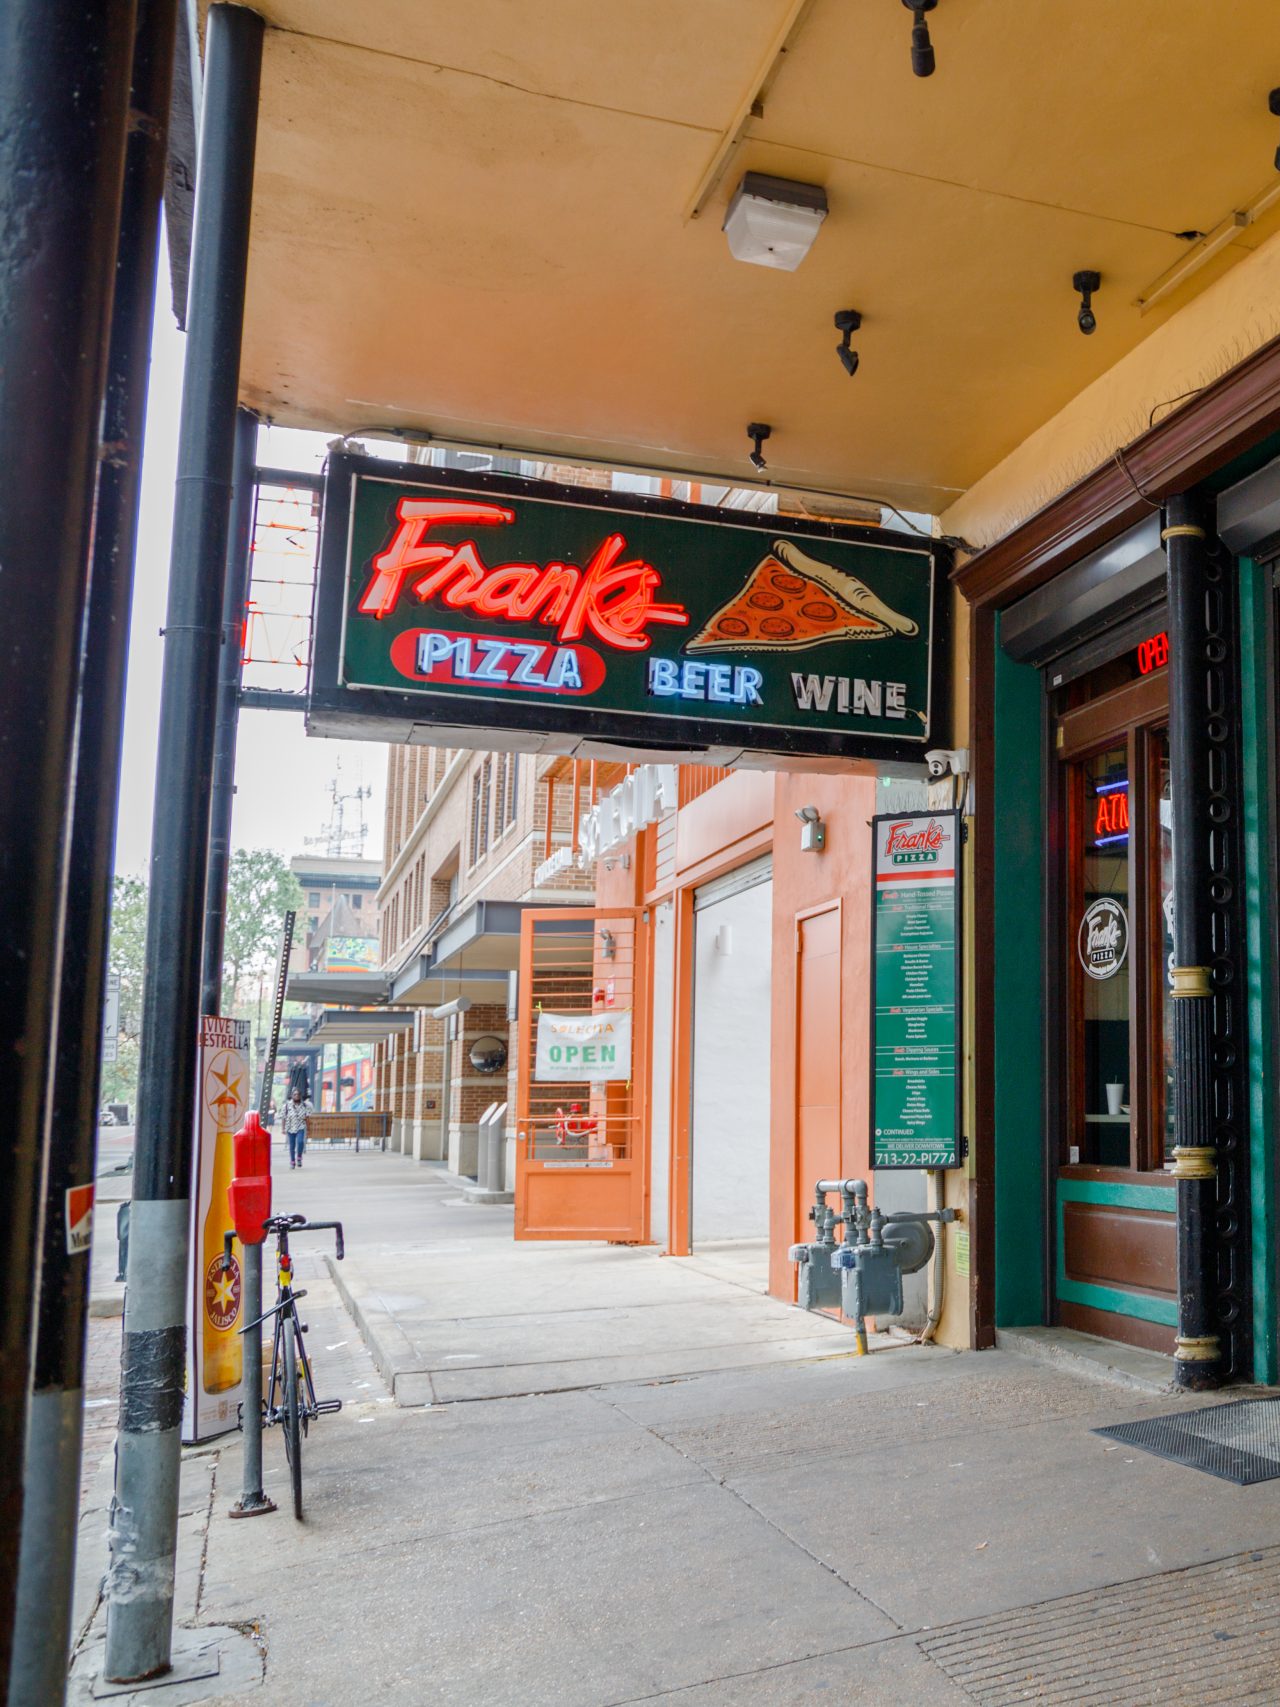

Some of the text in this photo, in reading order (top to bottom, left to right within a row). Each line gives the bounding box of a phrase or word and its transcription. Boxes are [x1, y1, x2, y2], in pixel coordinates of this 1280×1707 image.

[418, 632, 583, 688] PIZZA
[649, 656, 764, 706] BEER
[790, 672, 908, 719] WINE
[896, 854, 934, 863] PIZZA
[549, 1045, 616, 1063] OPEN
[883, 1128, 914, 1136] CONTINUED
[210, 1308, 237, 1326] JALISCO
